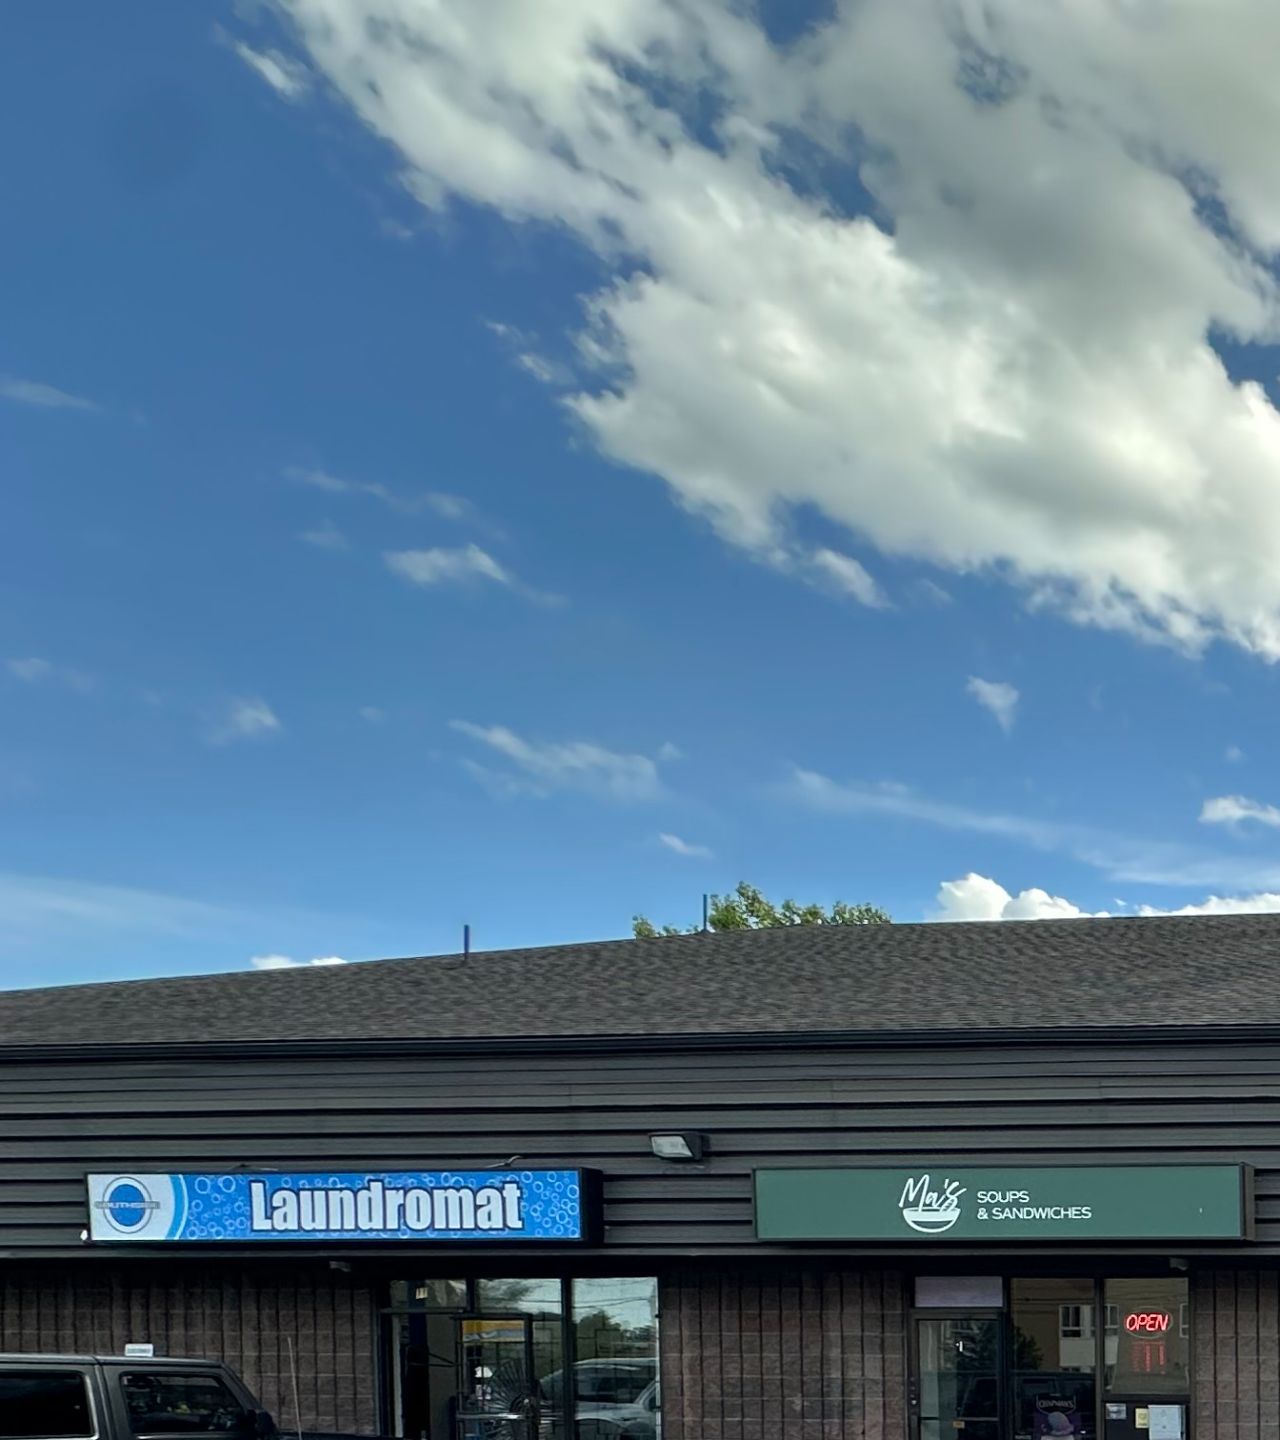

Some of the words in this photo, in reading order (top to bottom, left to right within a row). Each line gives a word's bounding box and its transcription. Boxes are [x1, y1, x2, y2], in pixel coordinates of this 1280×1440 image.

[898, 1174, 967, 1213] Ma's
[976, 1190, 1030, 1204] SOUPS
[250, 1180, 523, 1231] Laundromat
[976, 1208, 989, 1220] &
[991, 1206, 1092, 1220] SANDWICHES
[1126, 1313, 1169, 1331] OPEN
